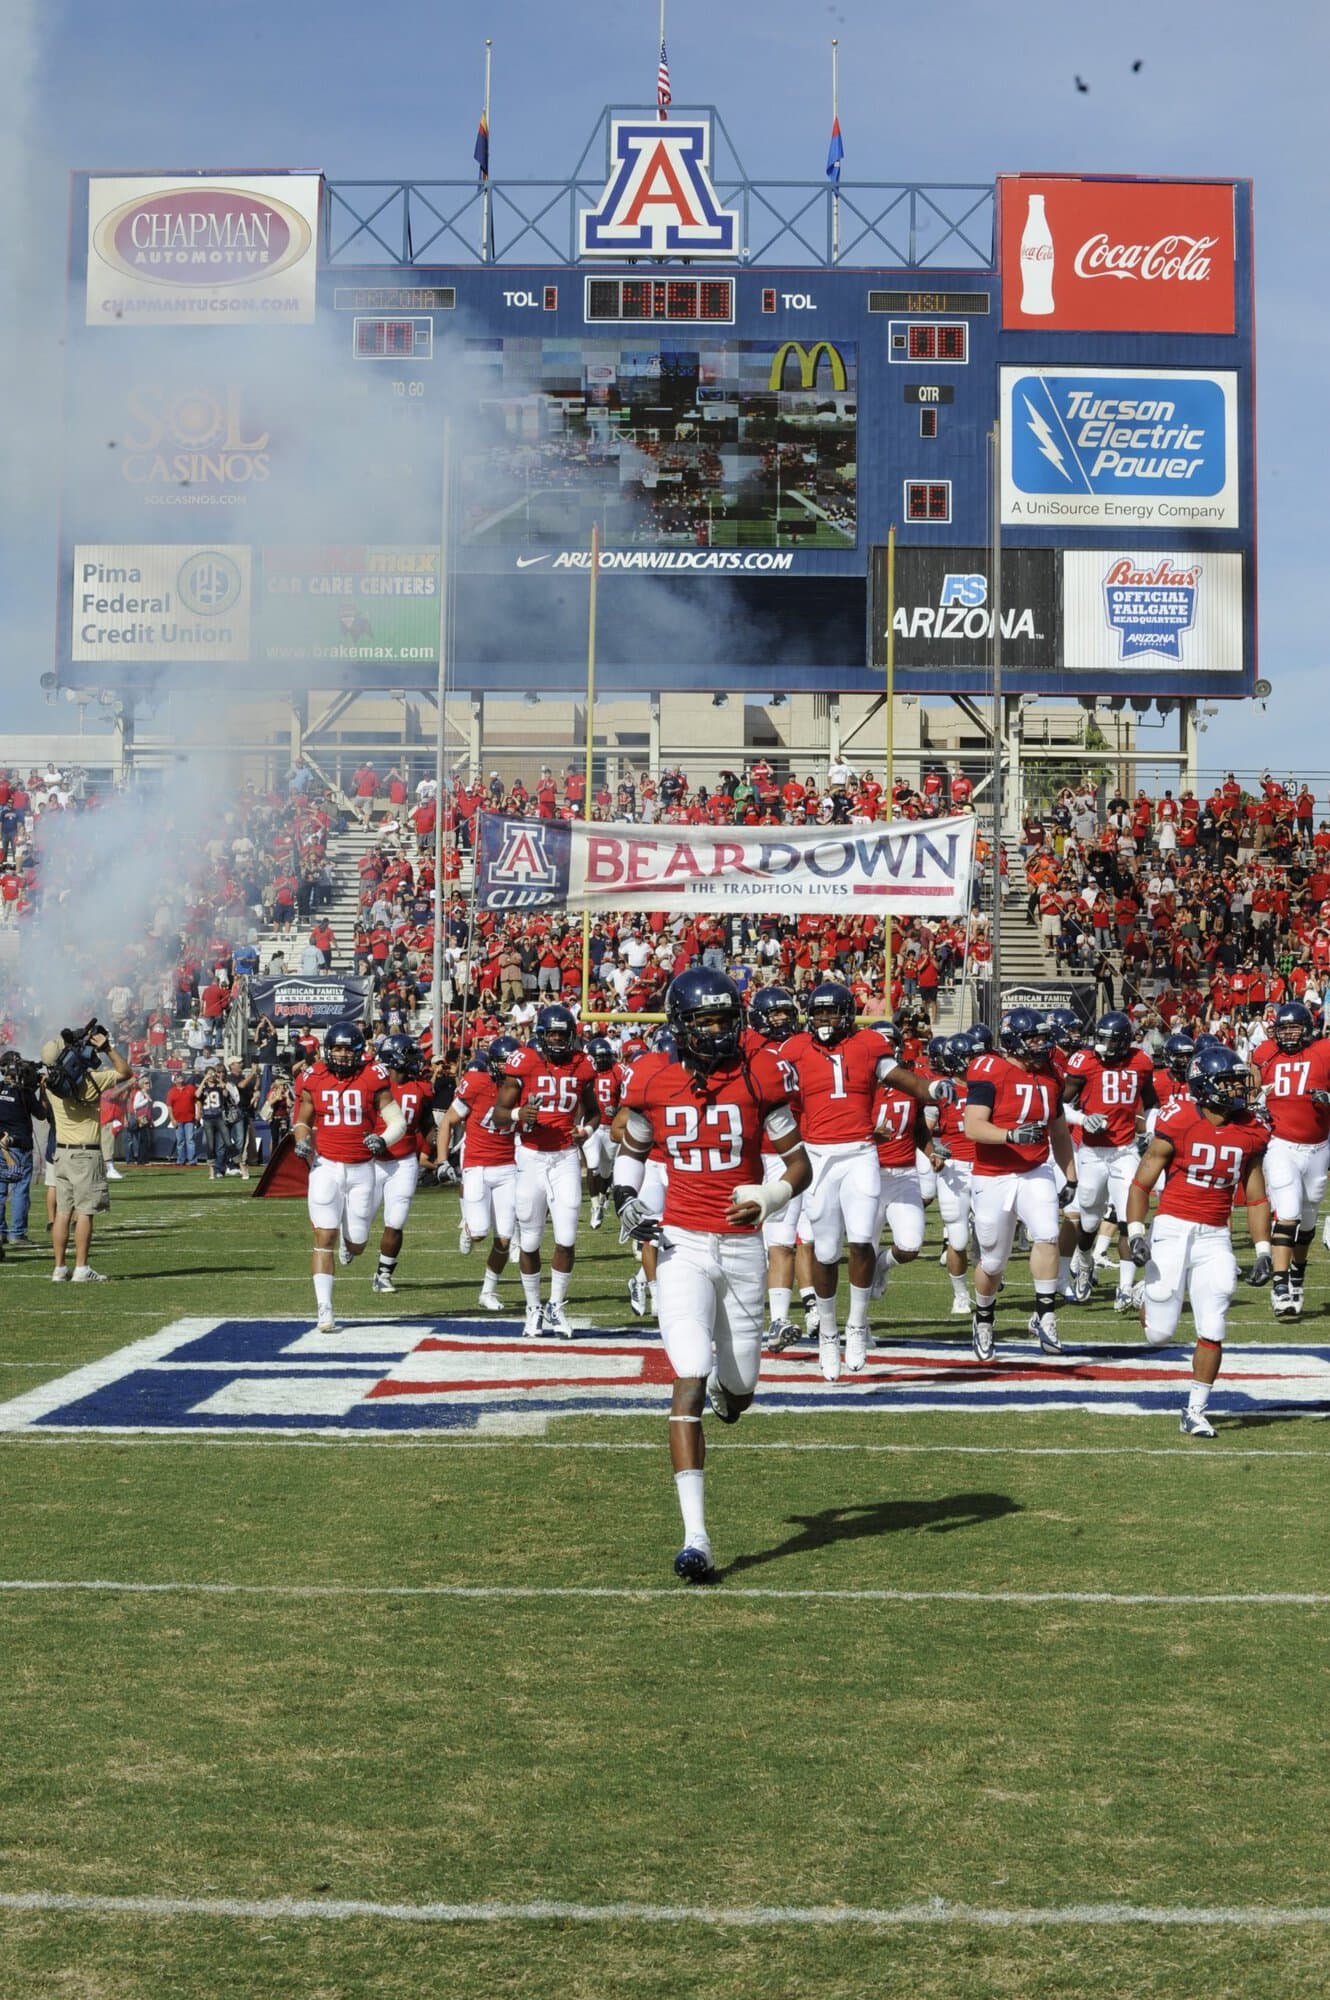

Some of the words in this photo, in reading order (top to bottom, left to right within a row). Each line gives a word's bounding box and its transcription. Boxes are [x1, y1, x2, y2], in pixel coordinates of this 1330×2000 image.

[579, 120, 740, 256] A
[130, 212, 273, 249] CHAPMAN
[134, 250, 271, 264] AUTOMOTIVE
[1073, 233, 1220, 281] Coca-Cola
[101, 298, 300, 313] CHAPMANTUCSON.COM
[503, 291, 539, 308] TOL
[781, 294, 817, 310] TOL
[391, 381, 405, 396] TO
[408, 381, 425, 396] GO
[918, 386, 940, 402] QTR
[1066, 391, 1176, 421] Tucson
[122, 384, 270, 451] SOL
[1077, 424, 1206, 450] Electric
[120, 454, 271, 483] CASINOS
[1090, 450, 1205, 479] Power
[1011, 501, 1022, 514] A
[1026, 502, 1099, 516] UniSource
[1104, 503, 1154, 519] Energy
[1157, 504, 1226, 519] Company
[551, 552, 794, 571] ARIZONAWILDCATS.COM
[83, 563, 142, 583] Pima
[1106, 560, 1199, 585] Bashas'
[308, 577, 354, 595] CARE
[360, 577, 436, 595] CENTERS
[82, 593, 171, 613] Federal
[1112, 591, 1189, 603] OFFICIAL
[1112, 604, 1189, 616] TAILGATE
[1113, 615, 1188, 625] HEADQUARTERS
[884, 606, 1036, 639] ARIZONA
[81, 624, 155, 644] Credit
[161, 624, 233, 644] Union
[1125, 633, 1176, 644] ARIZONA
[487, 821, 557, 887] A
[690, 883, 717, 895] THE
[722, 883, 803, 896] TRADITION
[808, 884, 849, 895] LIVES
[275, 987, 315, 995] AMERICAN
[316, 987, 344, 995] FAMILY
[1001, 994, 1042, 1002] AMERICAN
[1044, 994, 1072, 1002] FAMILY
[972, 1056, 995, 1073] 71
[830, 1054, 847, 1099] 1
[1274, 1061, 1311, 1097] 67
[537, 1075, 578, 1113] 26
[1101, 1069, 1138, 1105] 83
[321, 1089, 363, 1126] 38
[1015, 1083, 1050, 1126] 71
[665, 1103, 743, 1172] 23
[1185, 1142, 1243, 1189] 23
